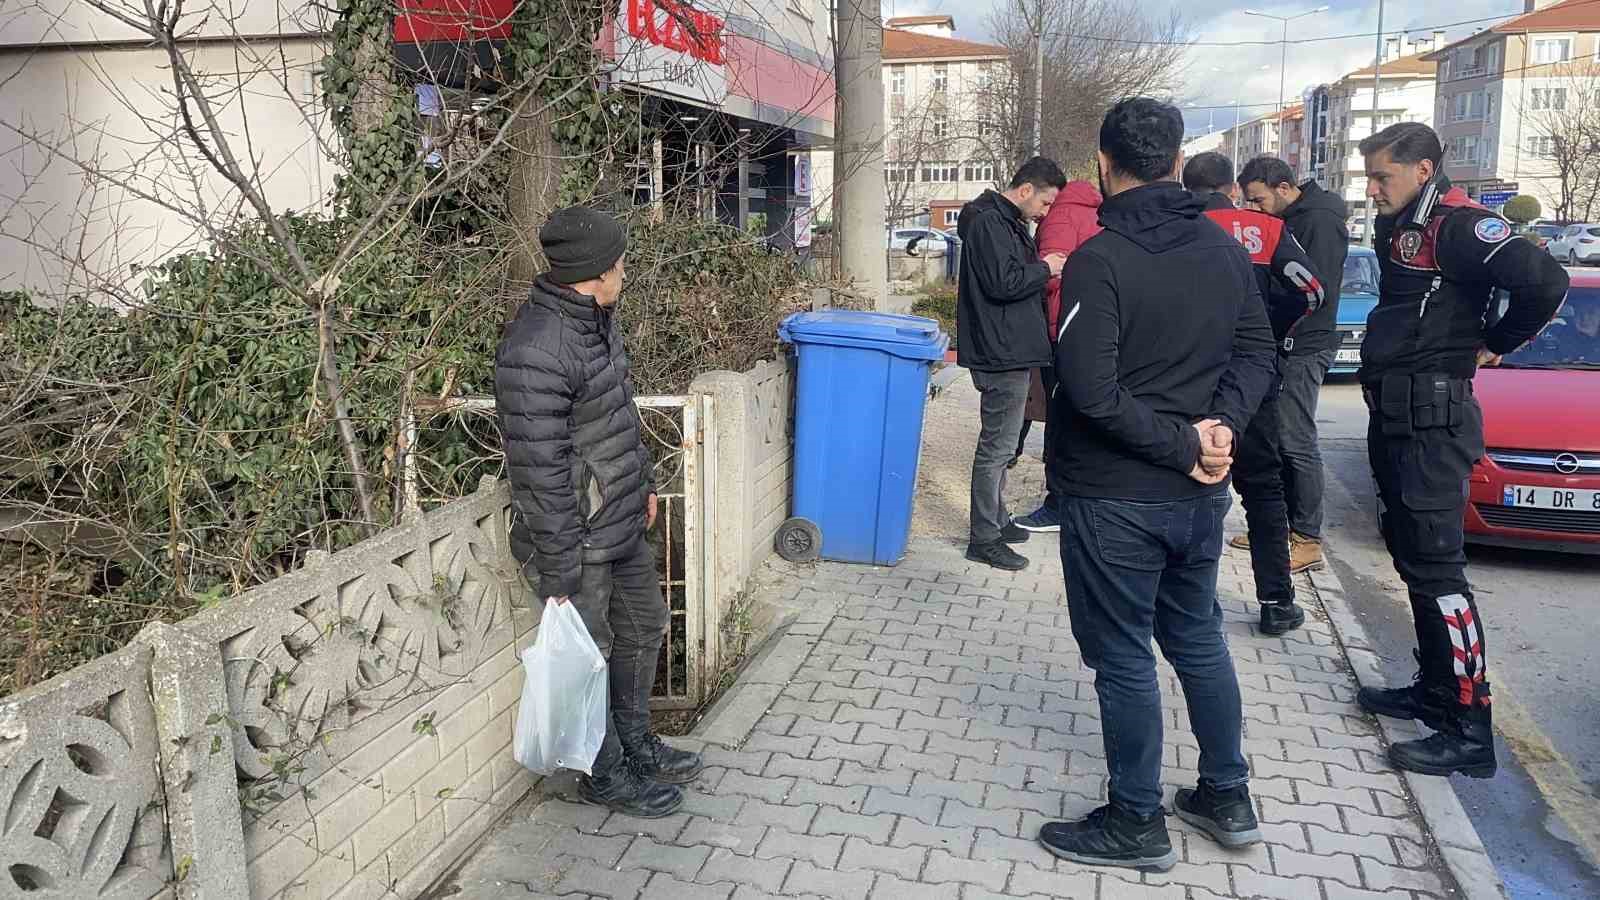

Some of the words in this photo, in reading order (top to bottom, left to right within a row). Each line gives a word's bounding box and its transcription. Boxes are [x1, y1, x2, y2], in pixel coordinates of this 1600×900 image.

[1232, 220, 1263, 254] İS
[1516, 487, 1535, 505] 14
[1552, 490, 1574, 508] DR
